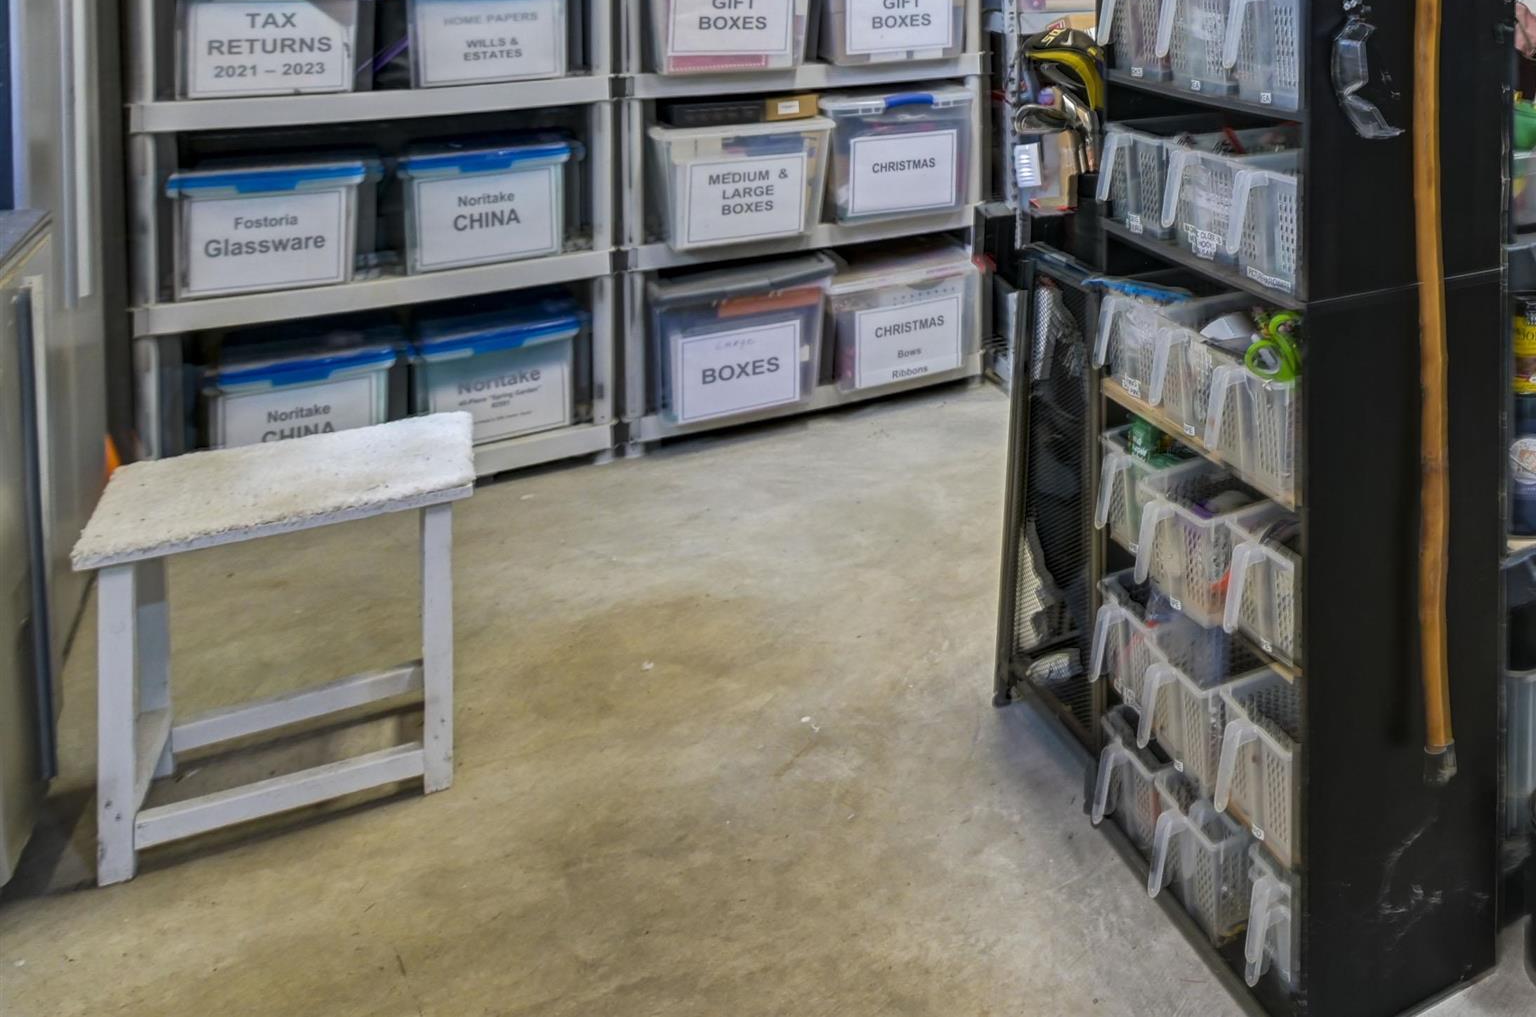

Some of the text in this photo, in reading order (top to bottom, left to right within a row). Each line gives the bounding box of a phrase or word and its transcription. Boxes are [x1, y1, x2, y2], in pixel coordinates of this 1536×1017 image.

[245, 12, 297, 29] TAX
[443, 11, 539, 27] HOME PAPERS
[698, 15, 768, 31] BOXES
[871, 13, 932, 30] BOXES
[206, 36, 333, 56] RETURNS
[465, 37, 519, 49] WILLS &
[463, 48, 523, 61] ESTATES
[213, 64, 259, 79] 2021
[281, 61, 326, 77] 2023
[872, 157, 936, 175] CHRISTMAS
[708, 168, 789, 186] MEDIUM &
[457, 190, 515, 208] Noritake
[722, 185, 775, 201] LARGE
[721, 200, 774, 216] BOXES
[233, 213, 298, 231] Fostoria
[453, 209, 521, 232] CHINA
[204, 233, 326, 259] Glassware
[875, 315, 945, 339] CHRISTMAS
[897, 347, 922, 359] Bows
[701, 357, 780, 385] BOXES
[892, 365, 929, 380] Ribbons
[457, 368, 542, 396] Noritake
[267, 402, 331, 424] Noritake
